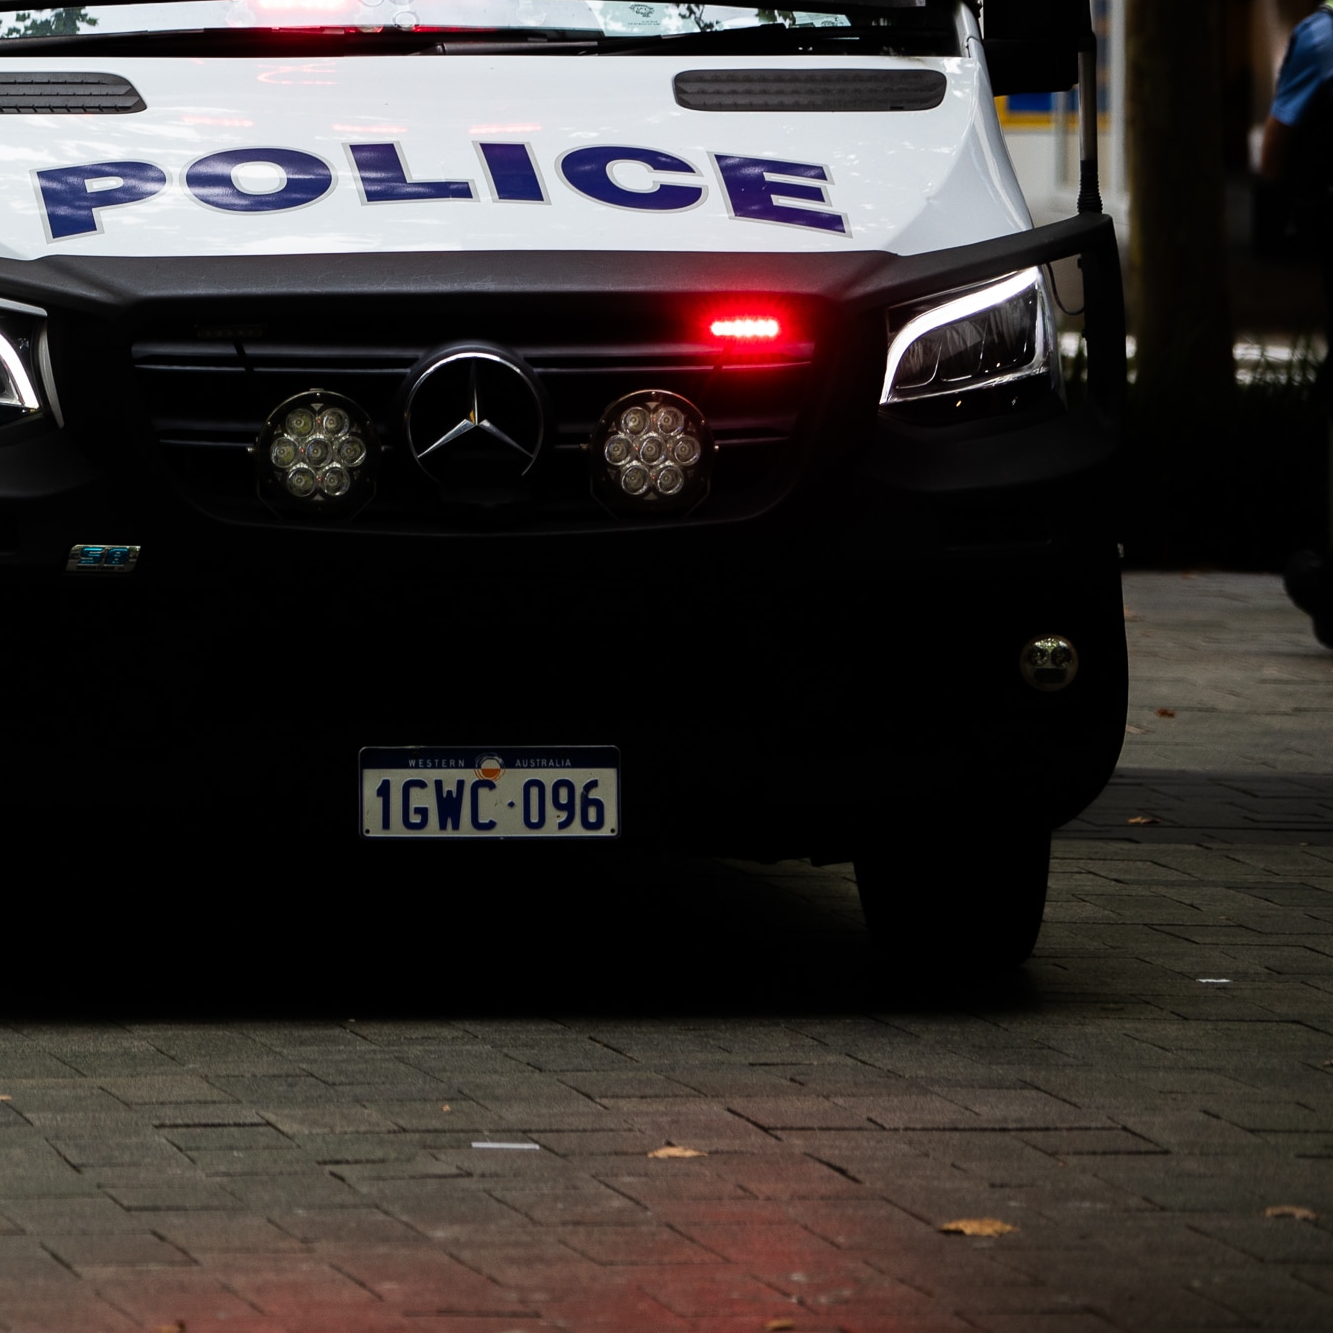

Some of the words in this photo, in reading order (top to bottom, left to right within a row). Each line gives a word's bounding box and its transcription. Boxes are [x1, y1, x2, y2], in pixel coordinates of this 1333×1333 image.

[30, 140, 853, 244] POLICE
[408, 758, 465, 768] WESTERN
[515, 758, 572, 768] AUSTRALIA
